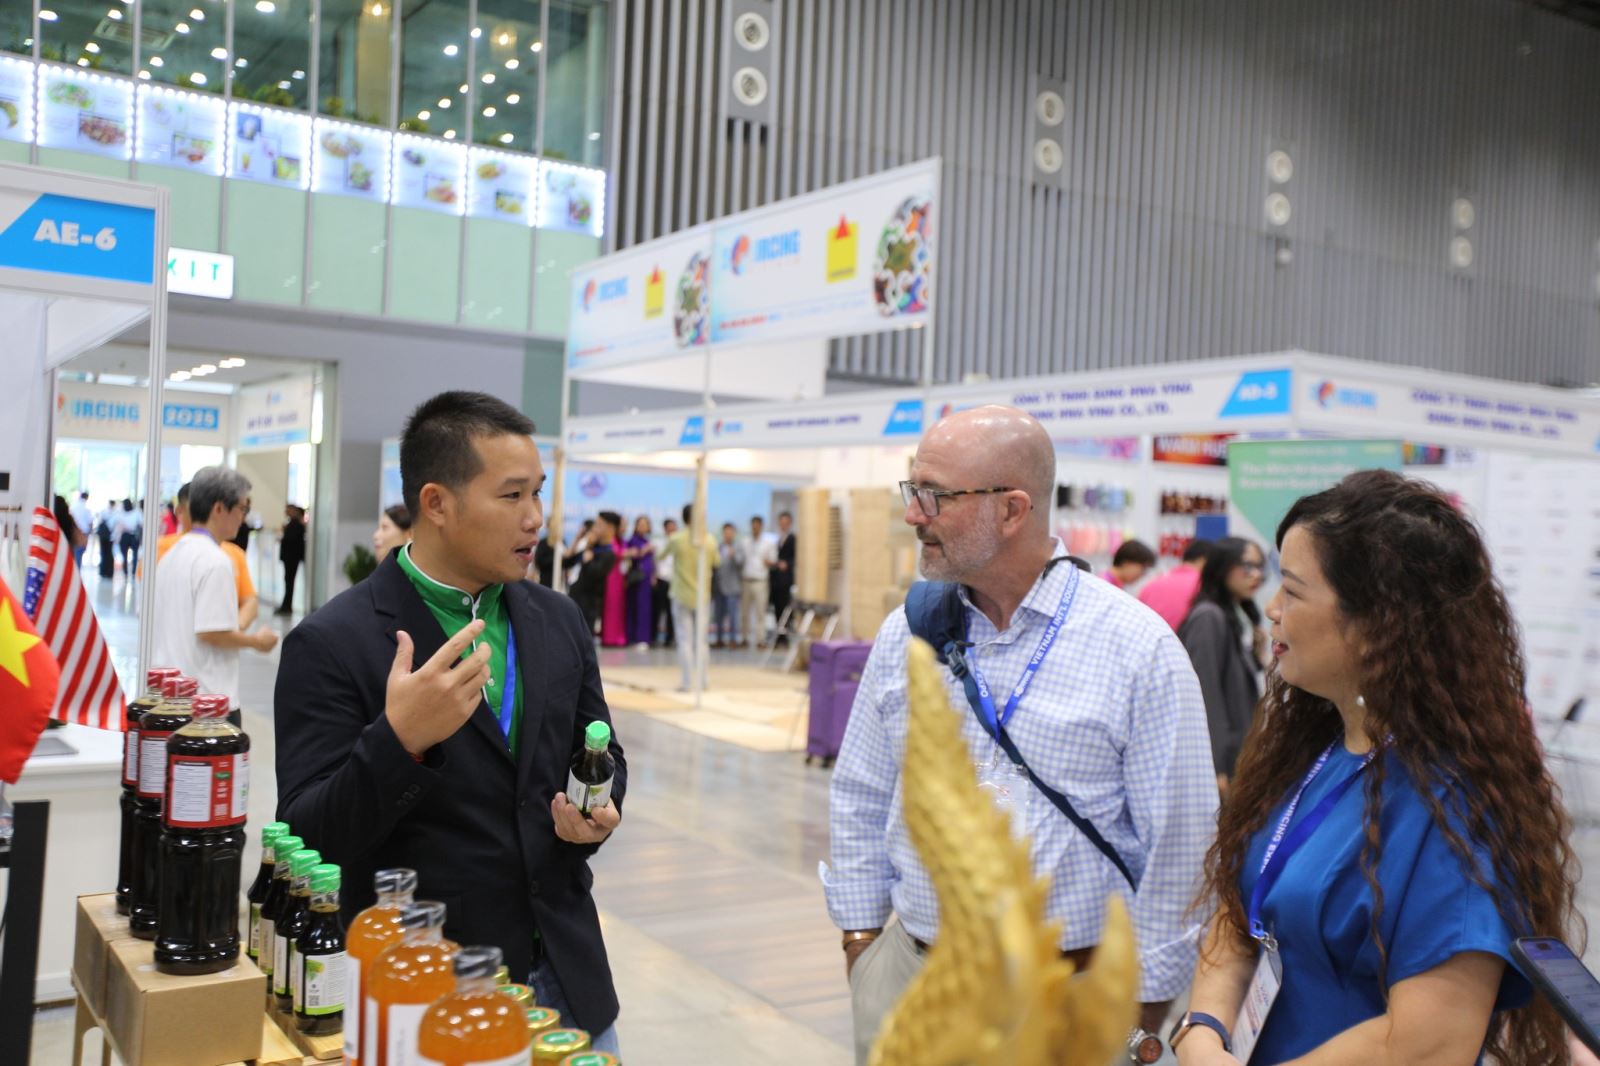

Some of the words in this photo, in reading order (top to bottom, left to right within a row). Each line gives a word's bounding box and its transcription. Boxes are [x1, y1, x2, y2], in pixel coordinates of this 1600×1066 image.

[34, 219, 117, 251] AE-6
[168, 257, 221, 281] XIT
[1031, 625, 1057, 665] VIETNAM
